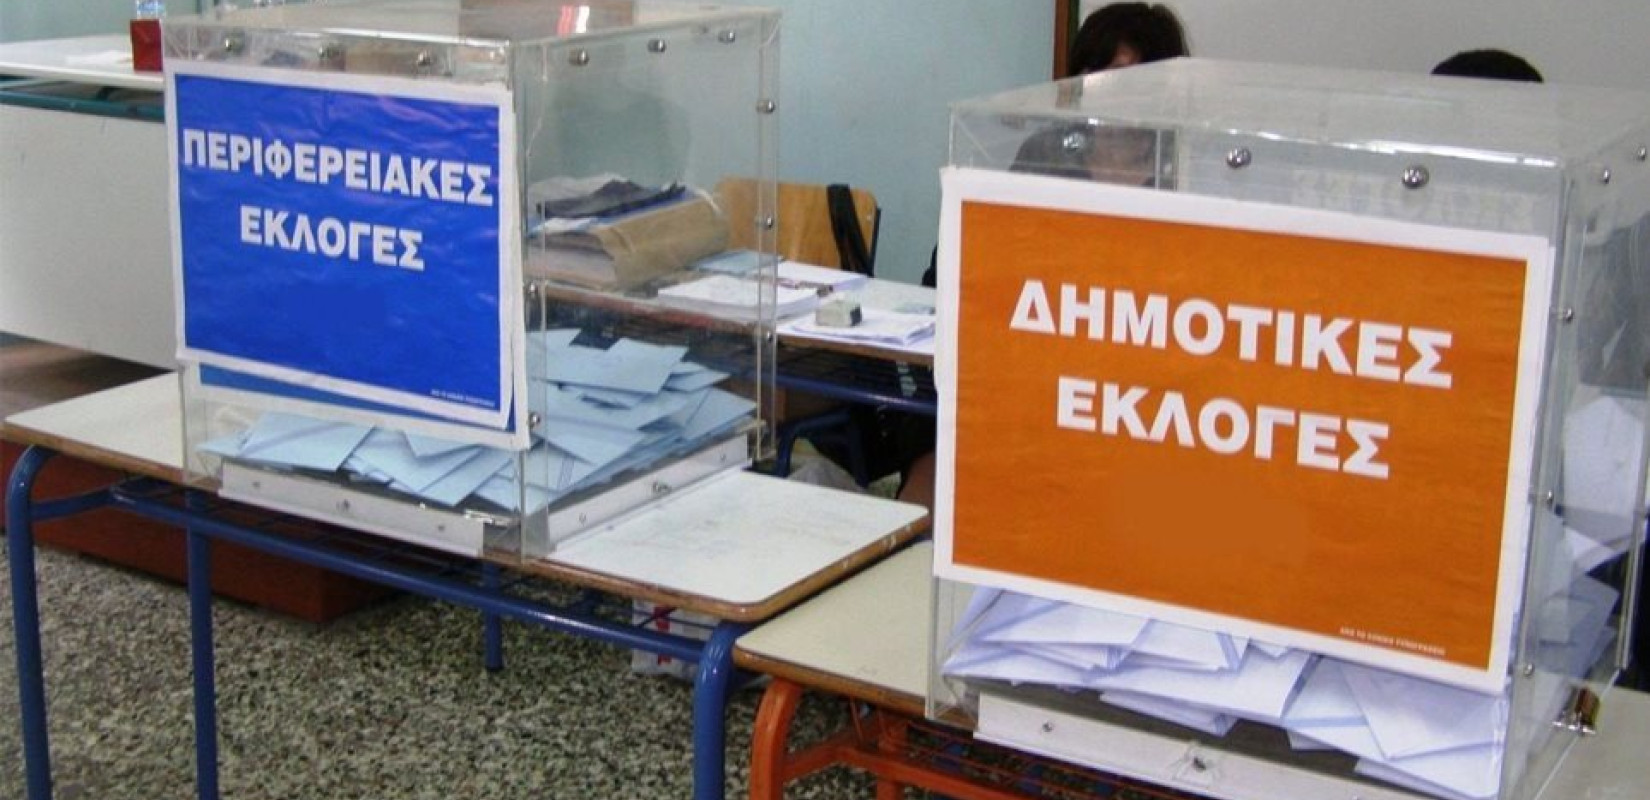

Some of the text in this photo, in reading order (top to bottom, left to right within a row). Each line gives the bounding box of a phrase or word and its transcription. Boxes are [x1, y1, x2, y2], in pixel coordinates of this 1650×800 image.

[183, 128, 493, 206] ΠΕΡΙΦΕΡΕΙΑΚΕΣ
[240, 205, 424, 270] ΕΚΛΟΓΕΣ
[1010, 279, 1453, 389] ΔΗΜΟΤΙΚΕΣ
[1056, 377, 1389, 479] ΕΚΛΟΓΕΣ
